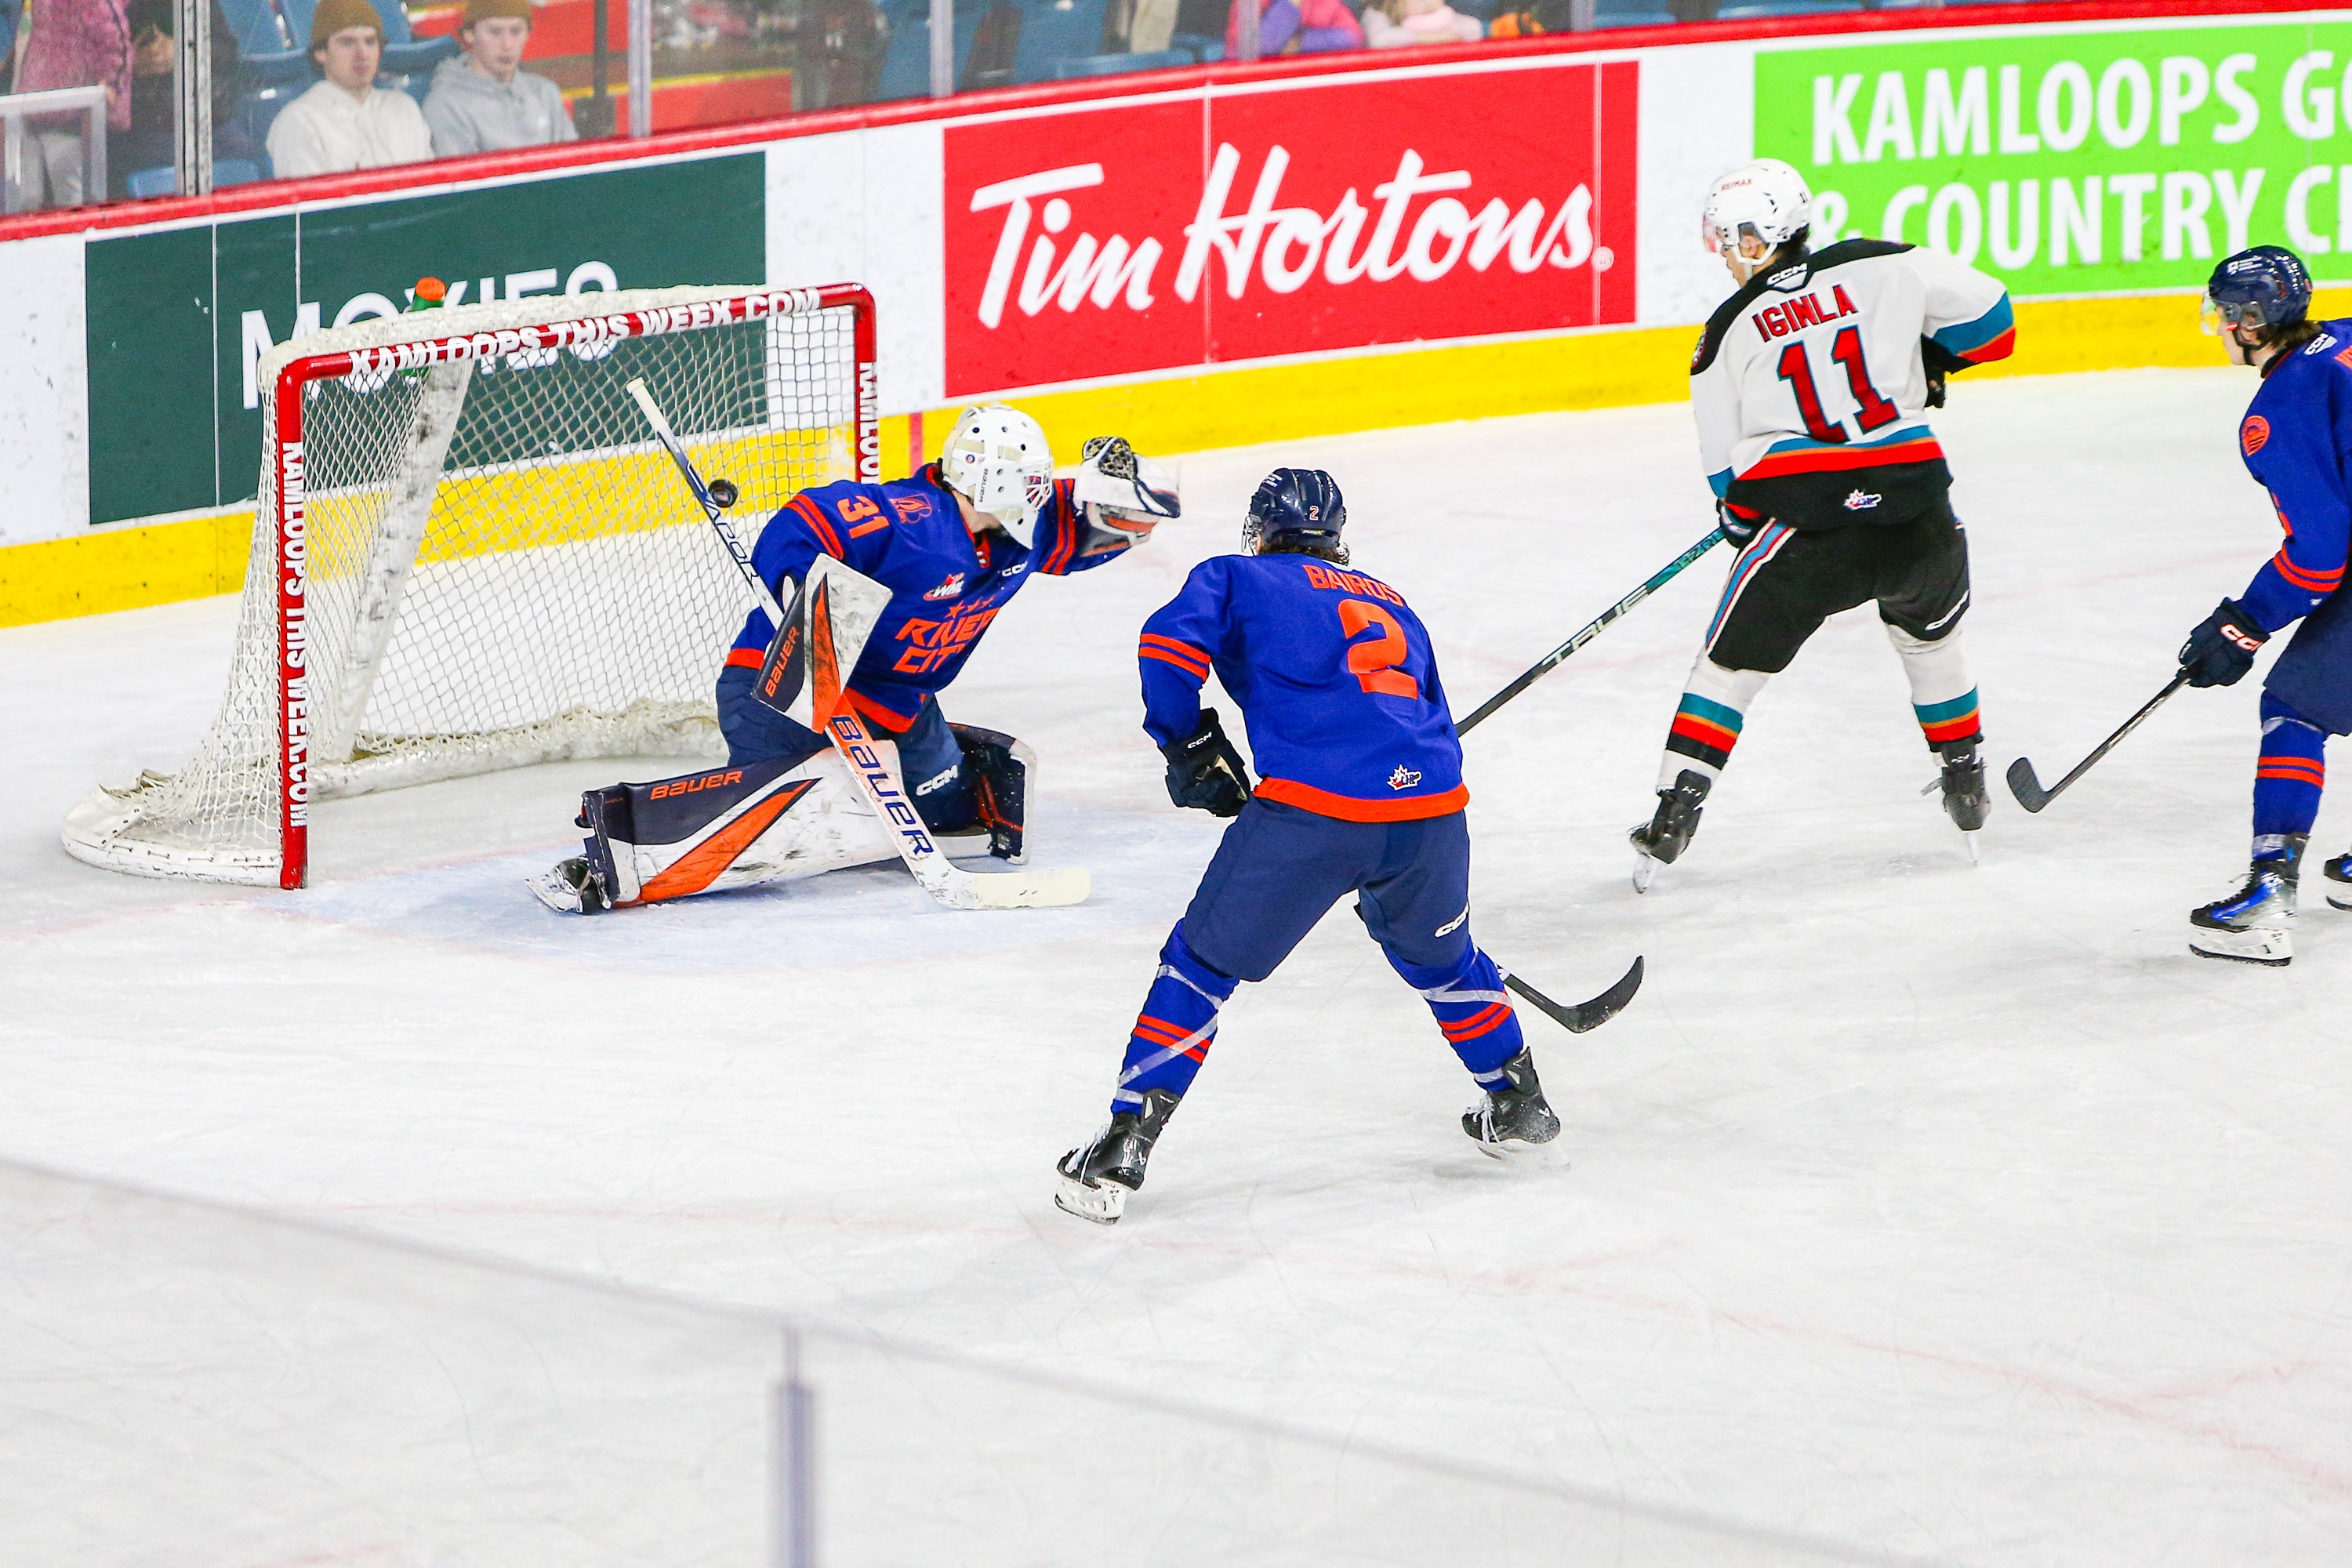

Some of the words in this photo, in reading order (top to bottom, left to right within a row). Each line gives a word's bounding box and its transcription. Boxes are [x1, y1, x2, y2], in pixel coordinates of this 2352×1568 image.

[1813, 53, 2260, 165] KAMLOOPS
[2282, 49, 2352, 140] G
[970, 162, 1163, 329] Tim
[1174, 141, 1593, 303] Hortons
[1882, 167, 2266, 269] COUNTRY
[1766, 263, 1808, 285] CCM
[350, 326, 543, 375] KAMLOOPS
[556, 314, 630, 349] THIS
[637, 288, 821, 338] WEEK.COM
[1751, 284, 1859, 343] IGINLA
[1777, 324, 1901, 444] 11
[282, 441, 305, 597] KAMLOOPS
[837, 495, 891, 539] 31
[1308, 505, 1319, 521] 2
[285, 608, 307, 669] THIS
[1338, 598, 1418, 700] 2
[1541, 584, 1649, 666] TRUE
[2220, 624, 2263, 652] CC
[764, 626, 800, 698] BAUER
[892, 643, 967, 674] CIT
[1188, 731, 1212, 749] CCM
[650, 771, 742, 800] BAUER
[830, 715, 934, 855] BAUER
[916, 764, 959, 797] CCM
